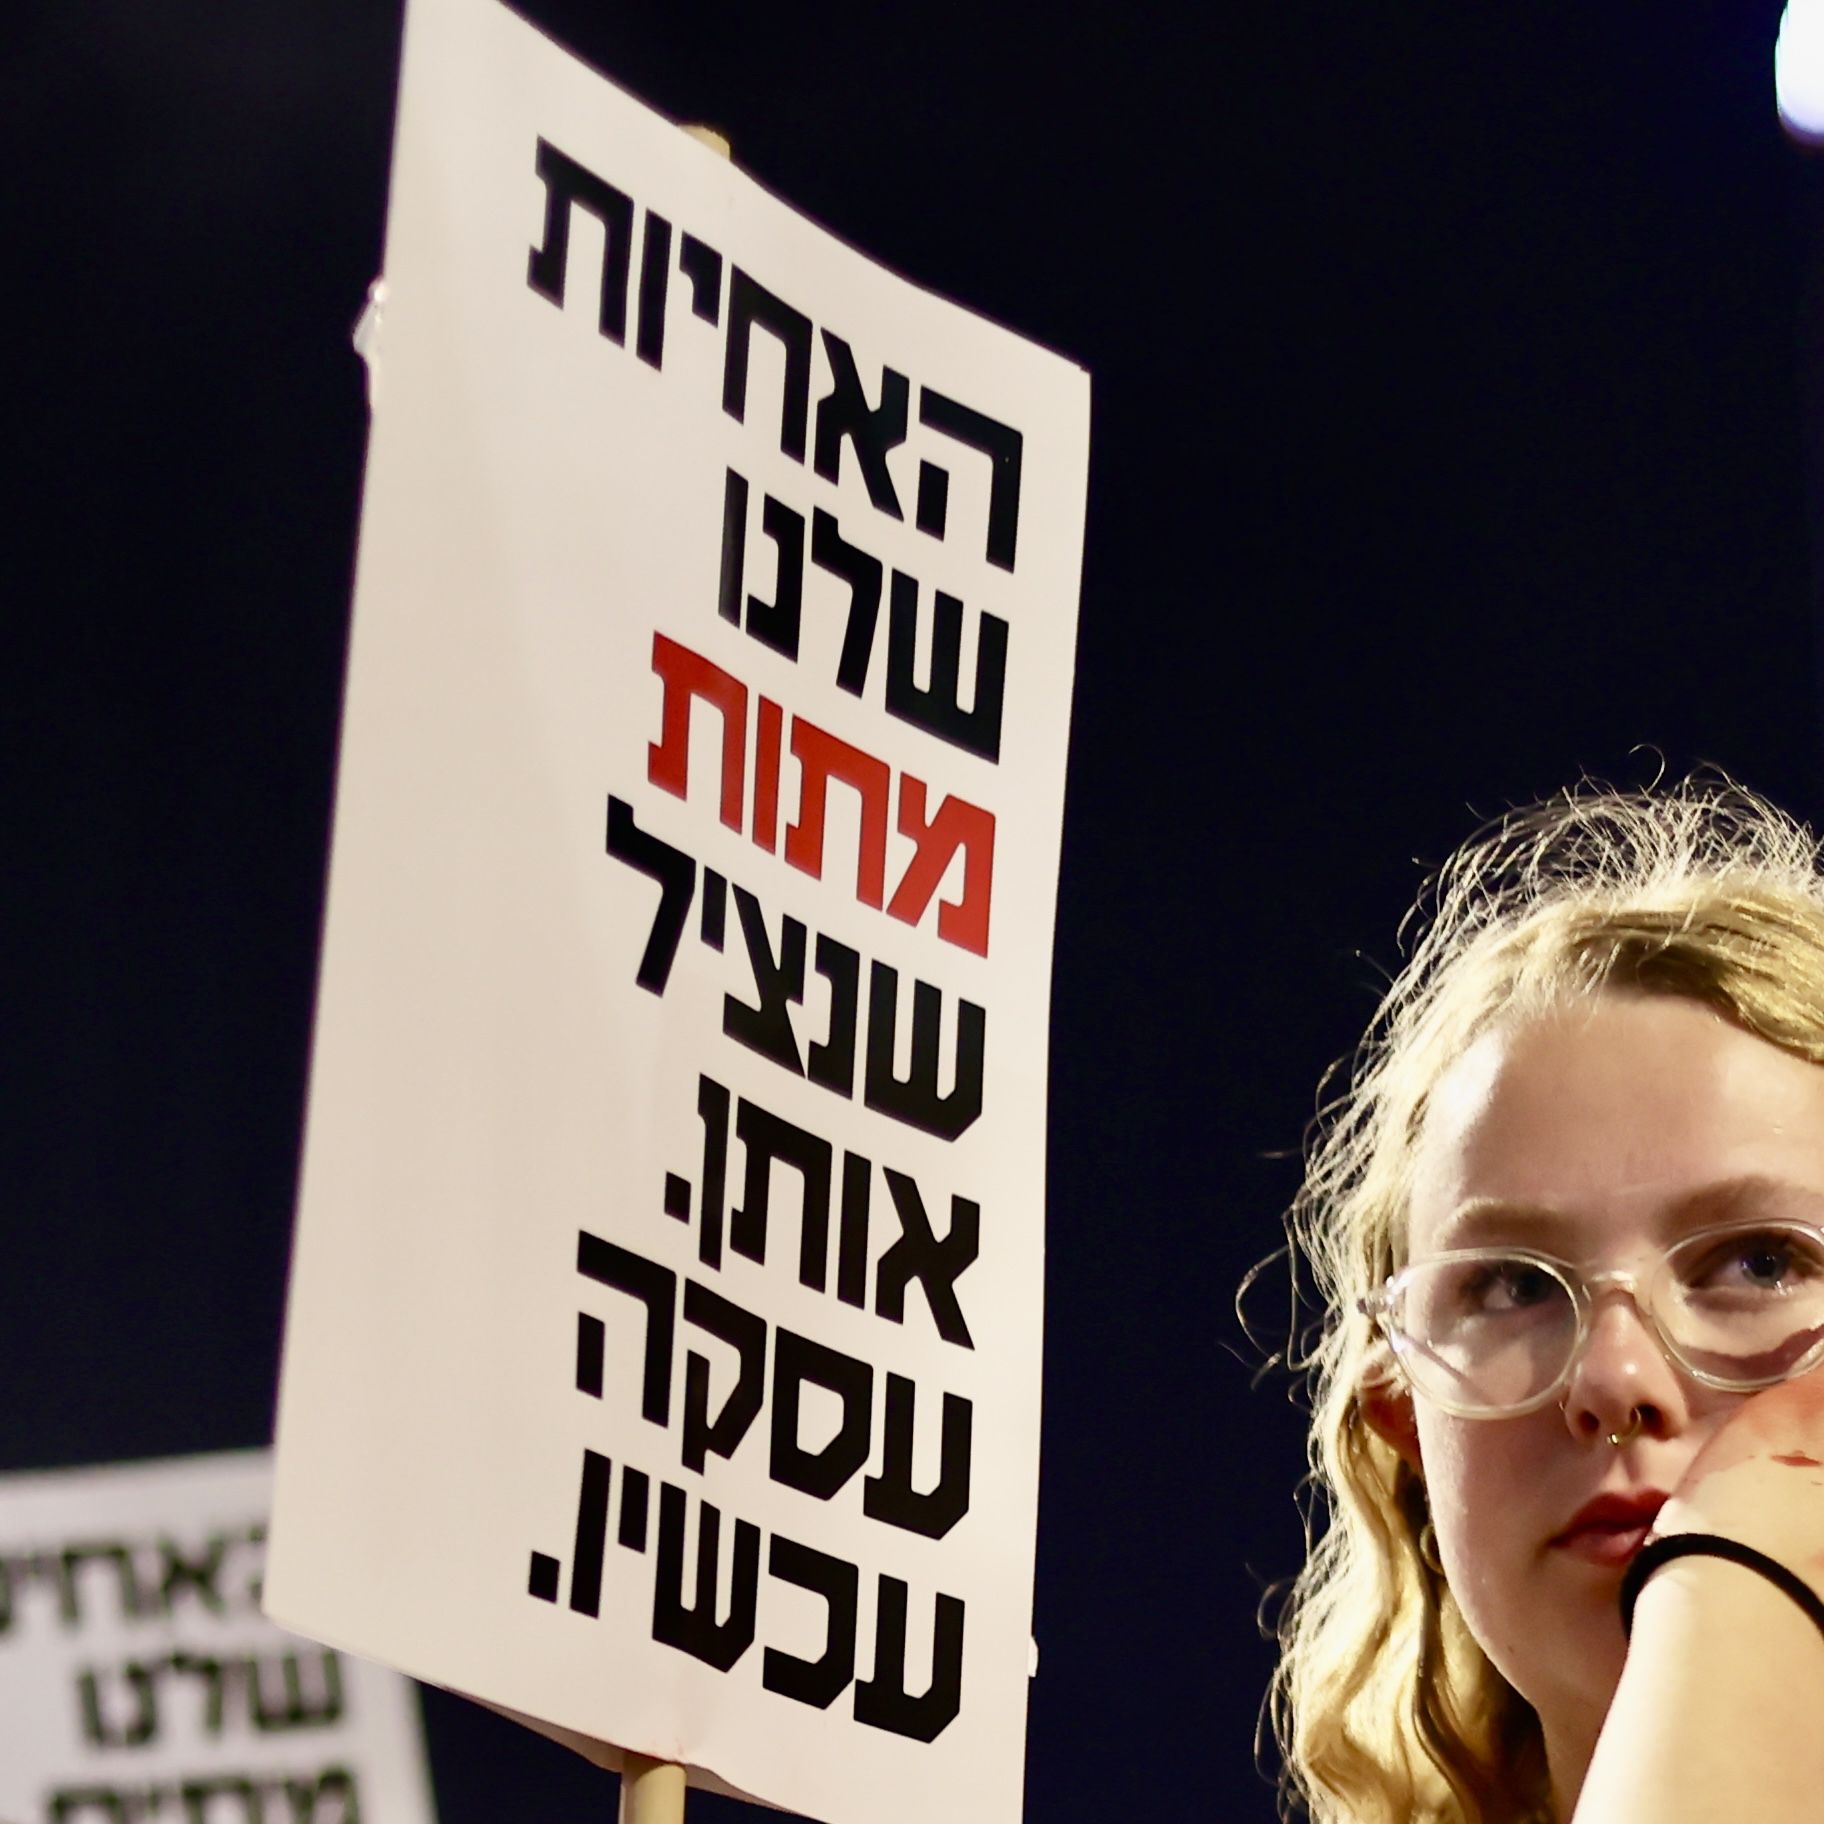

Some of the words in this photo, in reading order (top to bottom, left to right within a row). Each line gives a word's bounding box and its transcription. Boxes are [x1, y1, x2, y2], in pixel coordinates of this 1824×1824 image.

[526, 134, 1024, 575] האחיות
[718, 465, 1010, 765] שלנו
[647, 629, 996, 959] מתות
[605, 793, 986, 1142] שנציל
[664, 1072, 980, 1351] אותן.
[576, 1228, 973, 1541] עסקה
[76, 1645, 346, 1750] שלנו
[527, 1447, 965, 1745] עכשיו.
